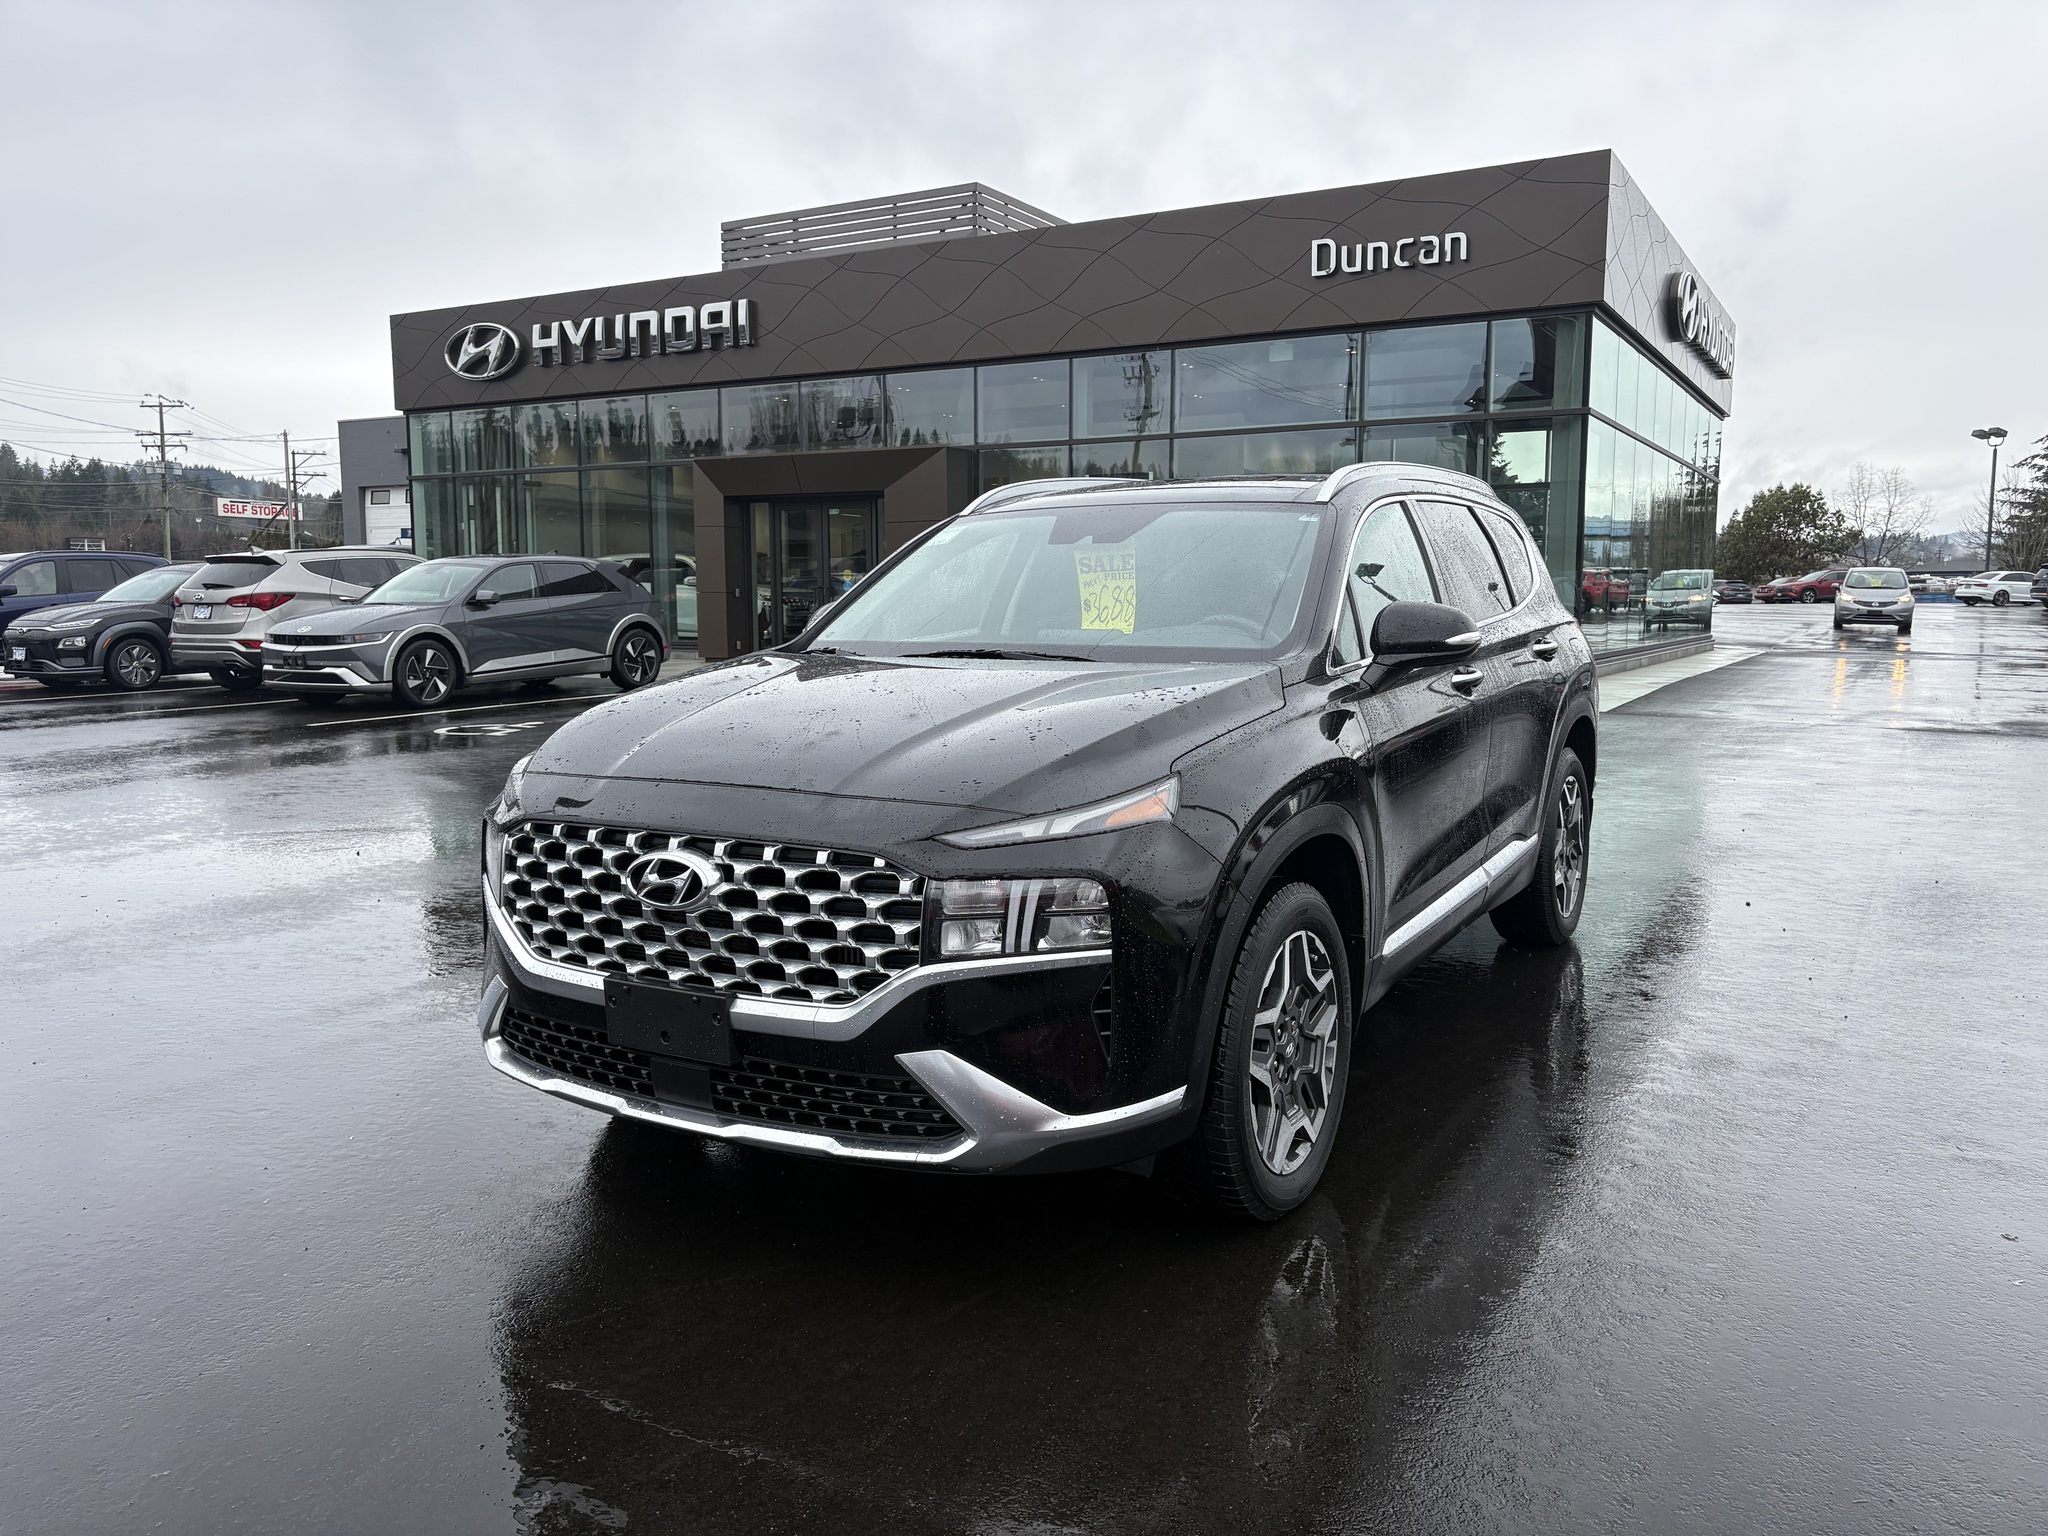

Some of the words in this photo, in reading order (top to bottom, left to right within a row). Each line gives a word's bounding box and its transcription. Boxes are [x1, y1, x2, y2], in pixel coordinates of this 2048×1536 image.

[1311, 231, 1468, 277] Duncan
[532, 298, 751, 367] HYUNDAI
[1699, 296, 1736, 378] HYUNDA
[222, 504, 248, 514] SELF
[1078, 554, 1134, 574] SALE
[1104, 572, 1135, 581] PRICE
